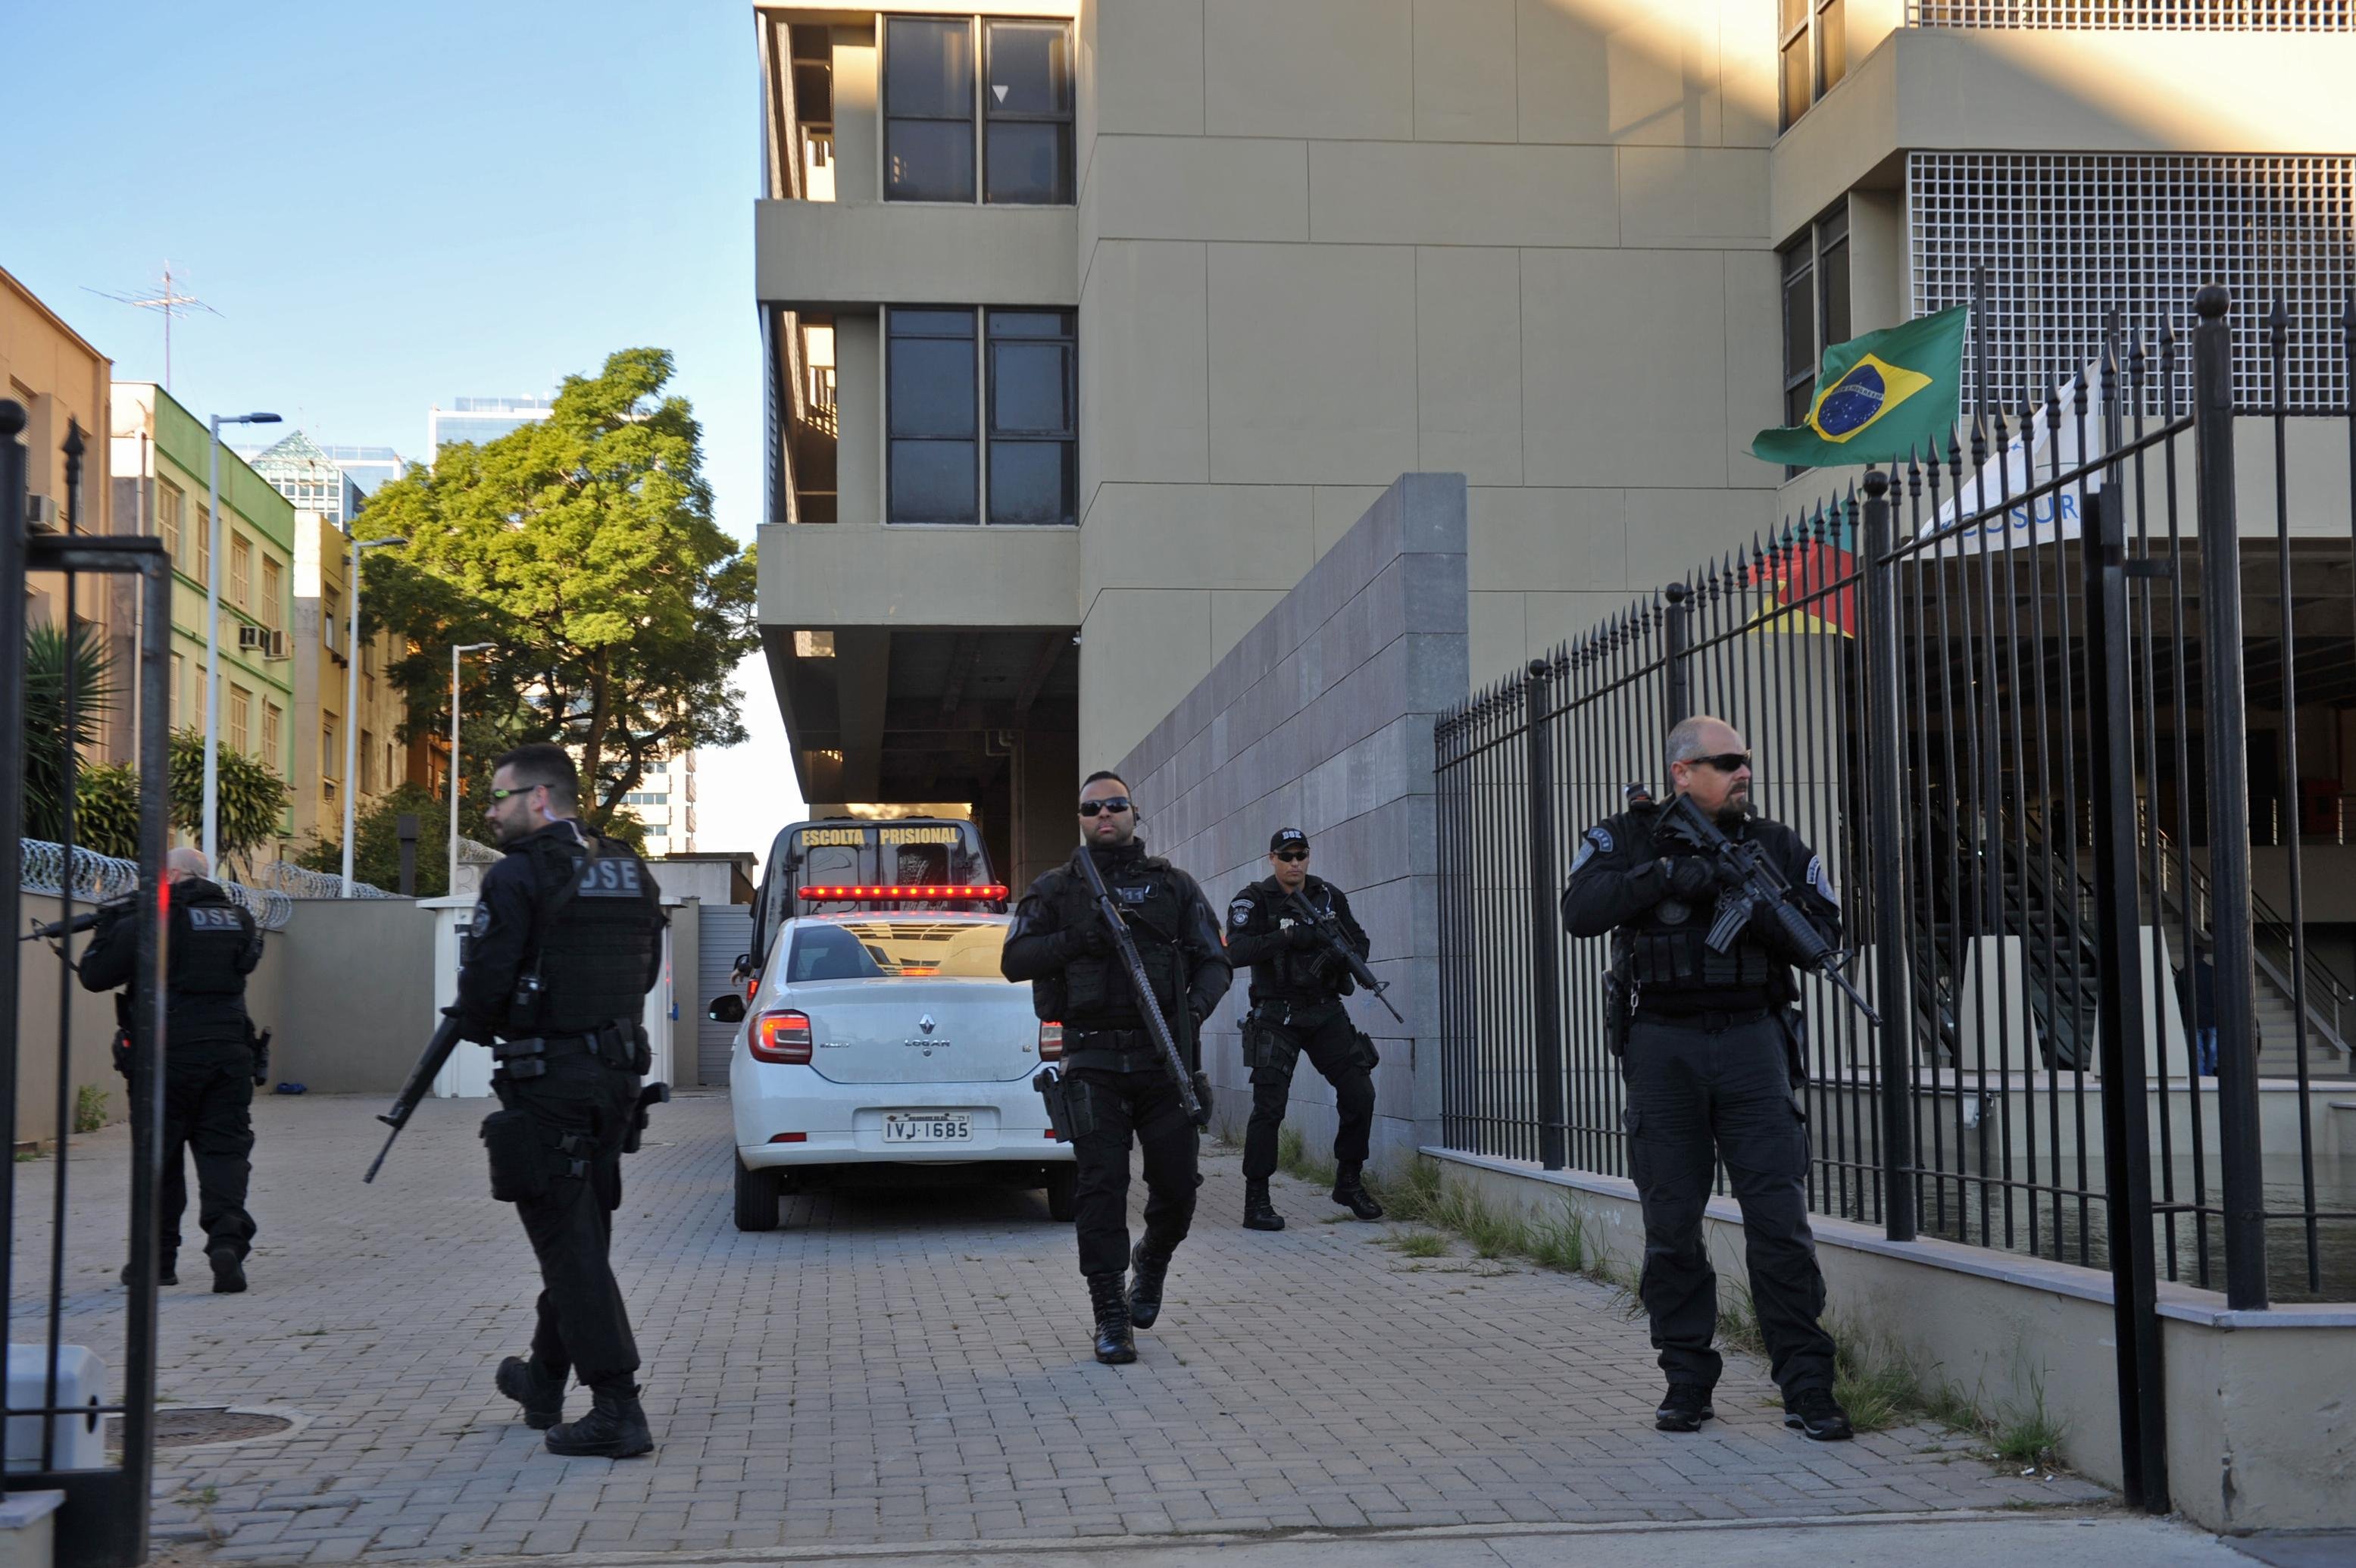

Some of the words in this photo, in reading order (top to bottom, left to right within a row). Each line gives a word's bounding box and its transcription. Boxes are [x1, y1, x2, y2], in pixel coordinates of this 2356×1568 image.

[801, 829, 864, 845] ESCOLTA
[880, 828, 958, 845] PRISIONAL
[1126, 891, 1142, 900] 11
[190, 909, 239, 925] DSE
